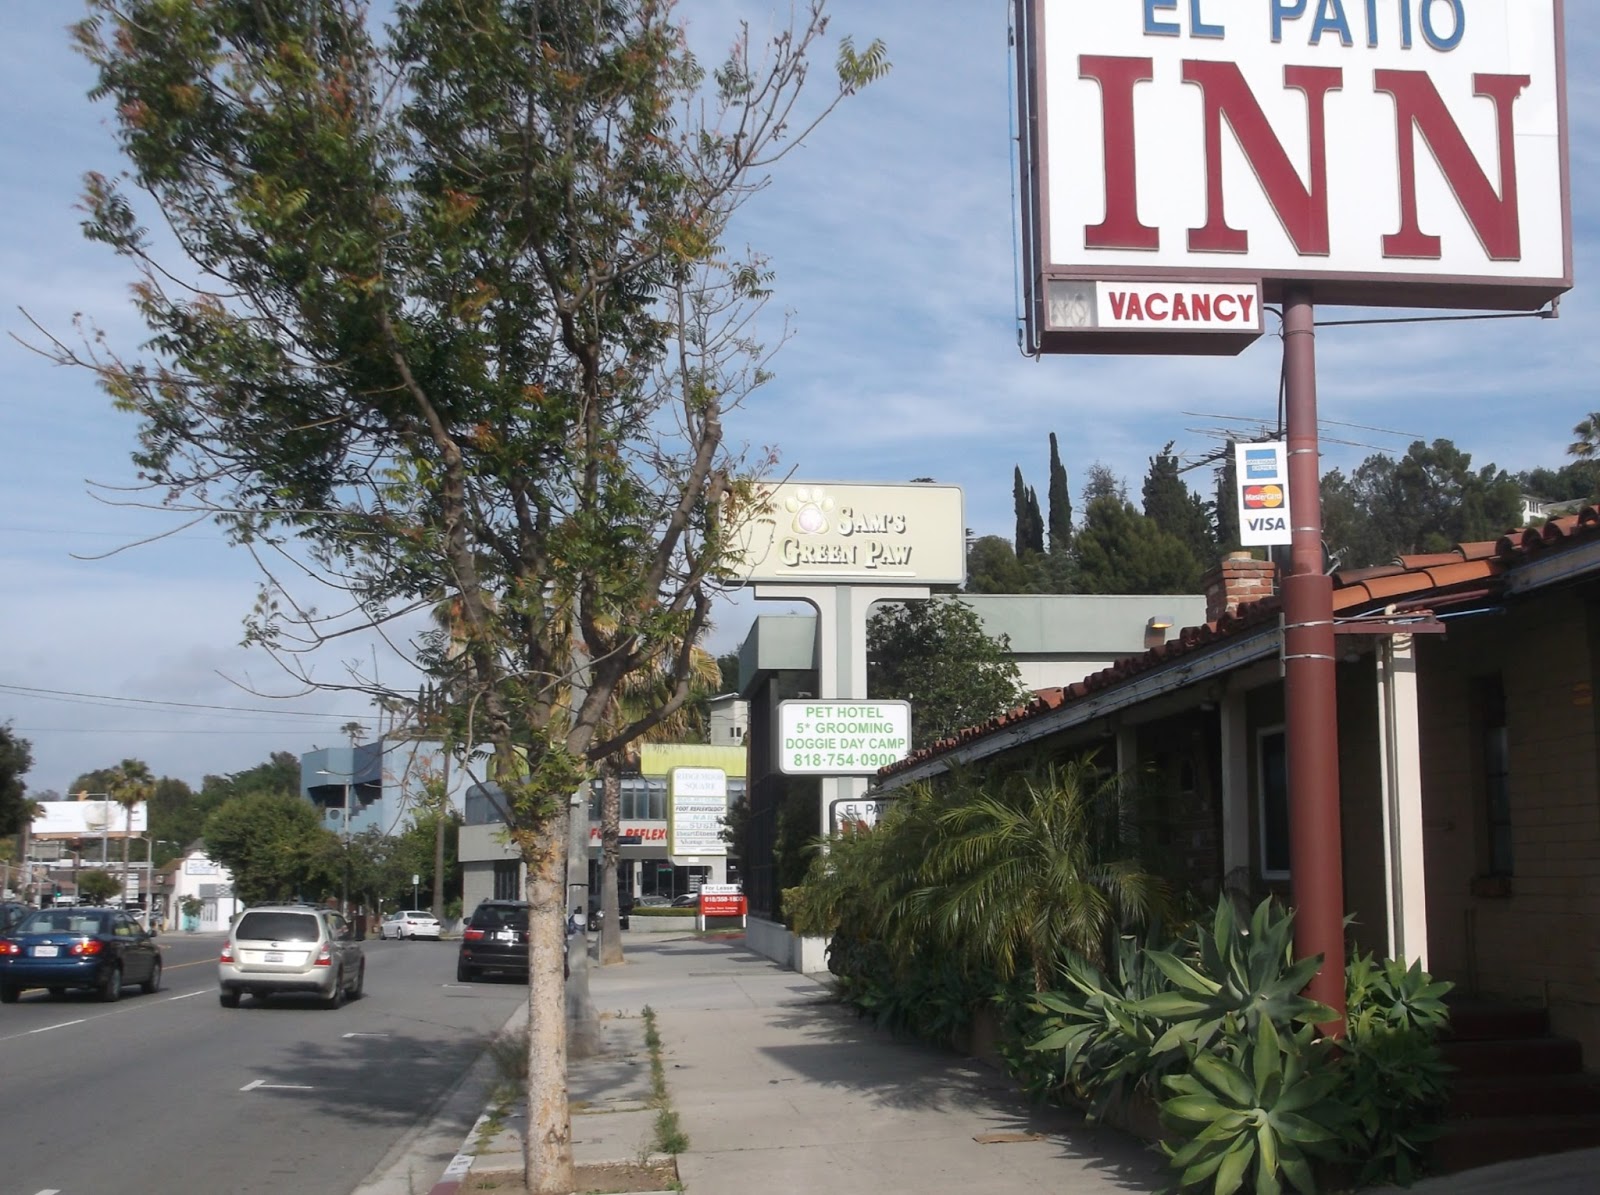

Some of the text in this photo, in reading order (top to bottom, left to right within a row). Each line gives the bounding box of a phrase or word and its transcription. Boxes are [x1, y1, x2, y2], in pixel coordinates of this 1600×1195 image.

[1143, 0, 1465, 51] EL PATIO
[1078, 54, 1531, 262] INN
[1108, 292, 1254, 322] VACANCY
[837, 506, 906, 536] SAM'S
[1246, 517, 1286, 531] VISA
[779, 536, 912, 569] GREEN PAW
[806, 707, 884, 719] PET HOTEL
[815, 722, 894, 734] GROOMING
[785, 738, 906, 750] DOGGIE DAY CAMP
[846, 803, 886, 816] EL PAT
